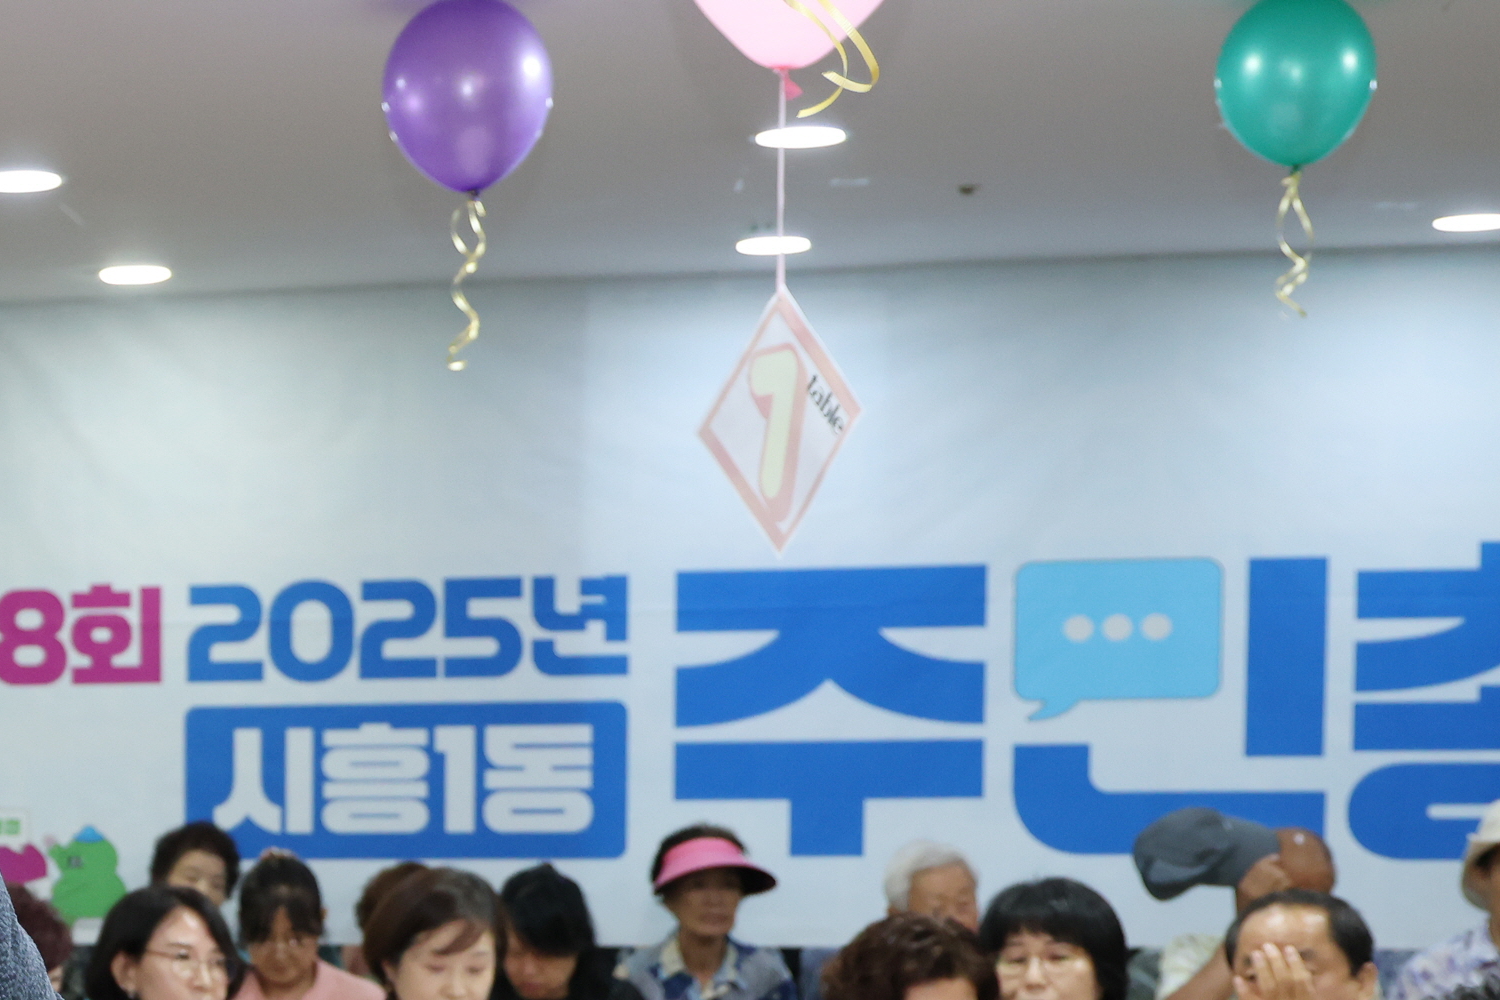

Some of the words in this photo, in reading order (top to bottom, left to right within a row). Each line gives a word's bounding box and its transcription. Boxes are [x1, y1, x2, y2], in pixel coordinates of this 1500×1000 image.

[807, 375, 844, 436] table
[187, 576, 629, 683] 2025년
[213, 722, 594, 834] 시흥1동
